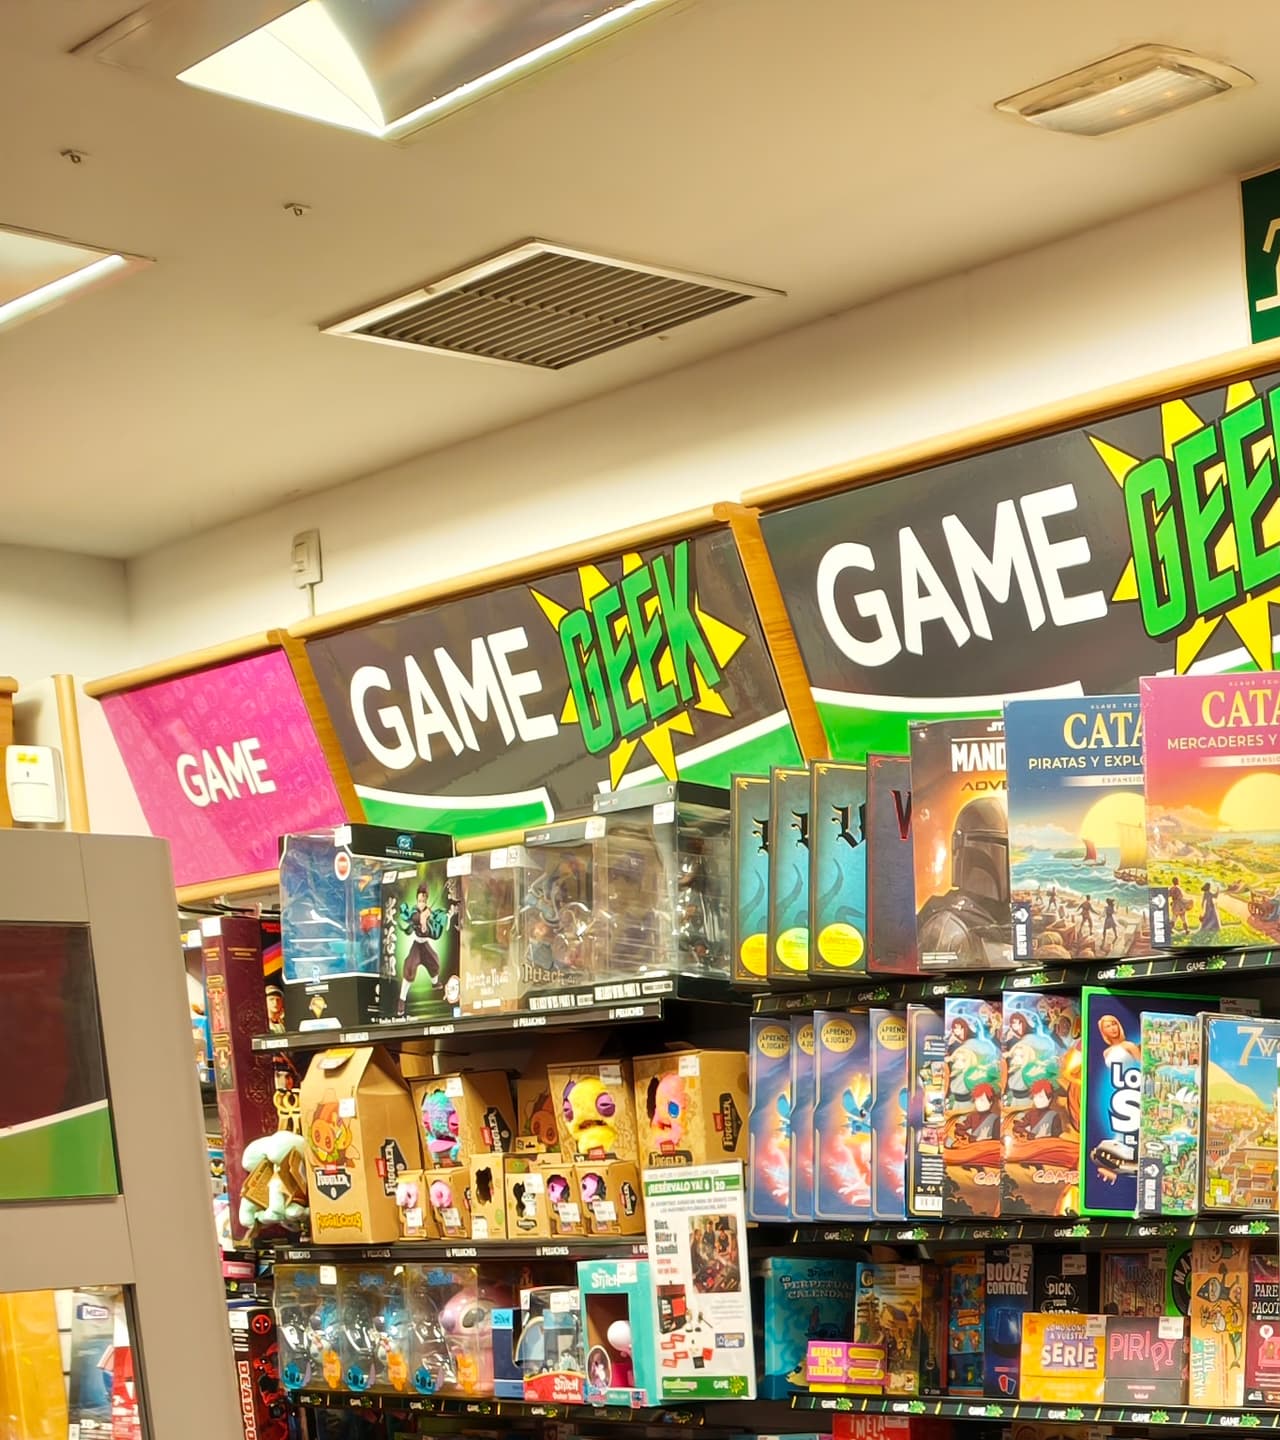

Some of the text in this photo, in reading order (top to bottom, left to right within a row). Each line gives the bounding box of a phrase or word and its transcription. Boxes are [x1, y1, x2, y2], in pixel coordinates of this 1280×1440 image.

[816, 483, 1108, 667] GAME
[350, 539, 720, 769] GAME GEEK
[1168, 736, 1278, 750] MERCADERES Y
[176, 738, 276, 807] GAME
[1029, 756, 1100, 770] PIRATAS Y
[986, 1263, 1028, 1283] BOOZE
[986, 1280, 1028, 1296] CONTROL
[1040, 1344, 1097, 1370] SERIE
